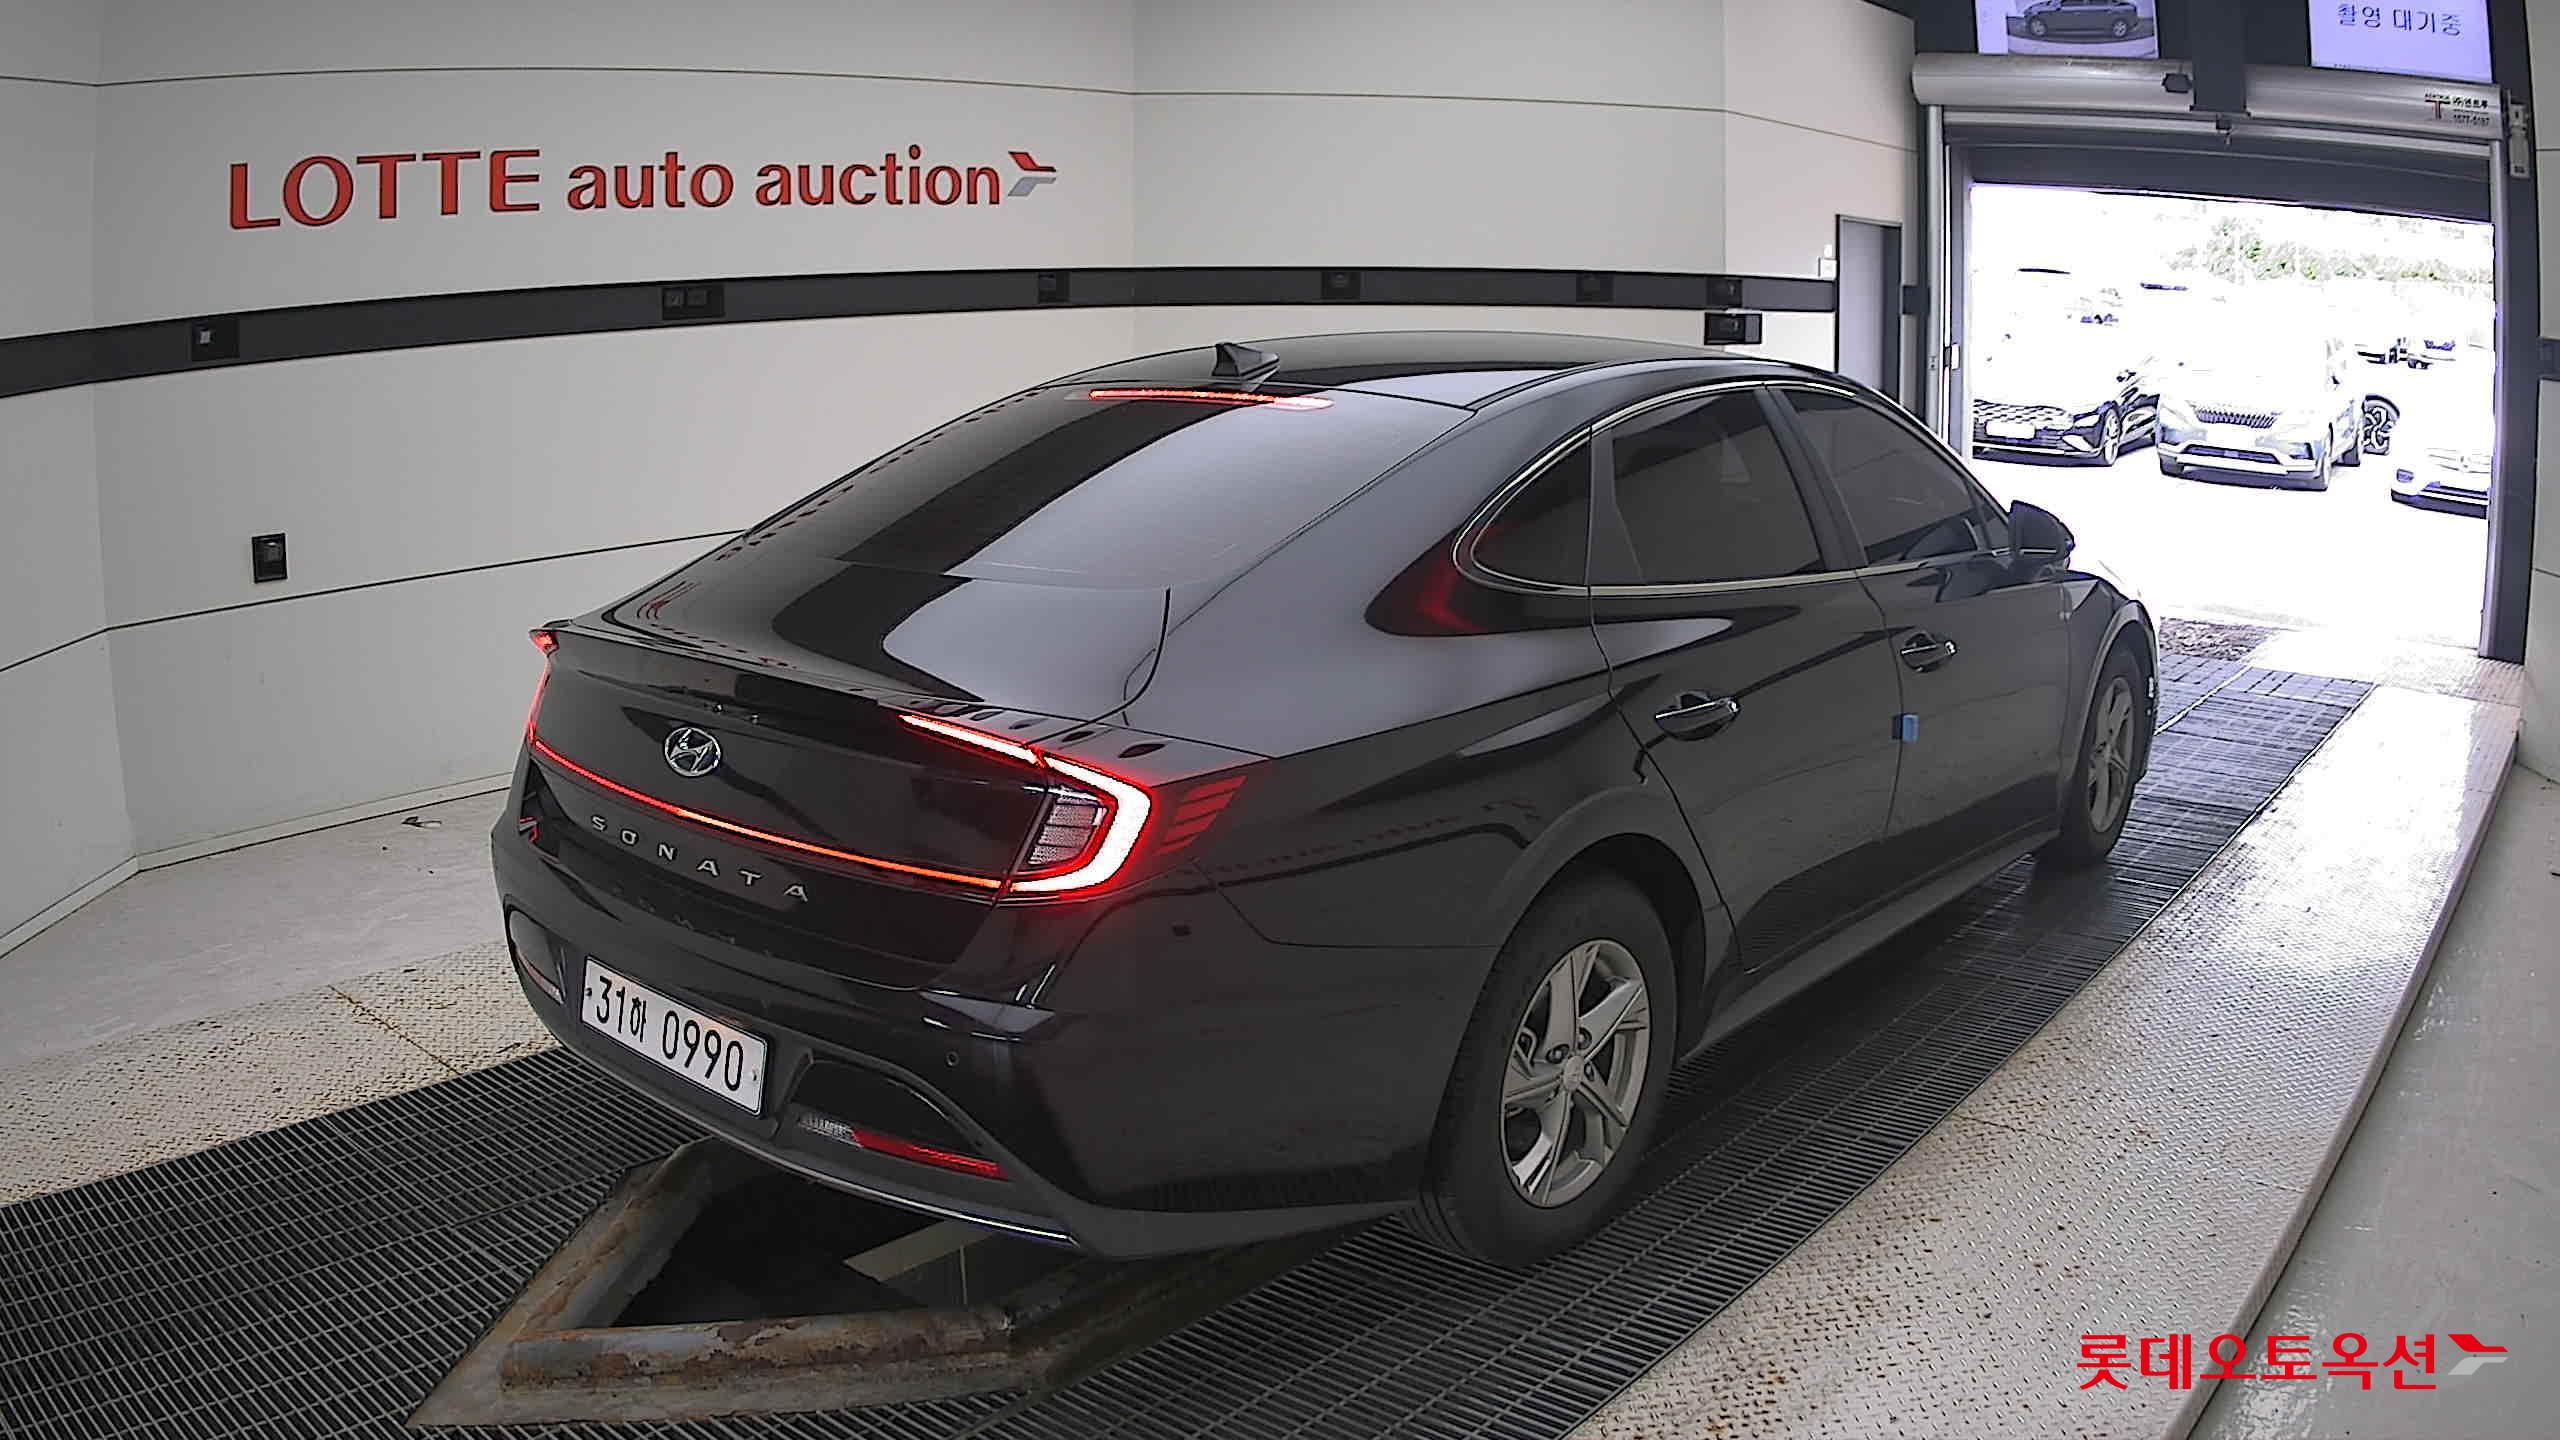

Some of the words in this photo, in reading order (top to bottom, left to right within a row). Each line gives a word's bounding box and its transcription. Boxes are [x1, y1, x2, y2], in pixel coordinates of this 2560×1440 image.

[2337, 3, 2382, 29] 촬영
[2392, 8, 2462, 37] 대기중
[229, 148, 541, 231] LOTTE
[566, 150, 735, 211] auto
[755, 144, 1002, 207] auction
[590, 814, 809, 903] SONATA
[595, 975, 647, 1043] 31하
[662, 1009, 744, 1092] 0990
